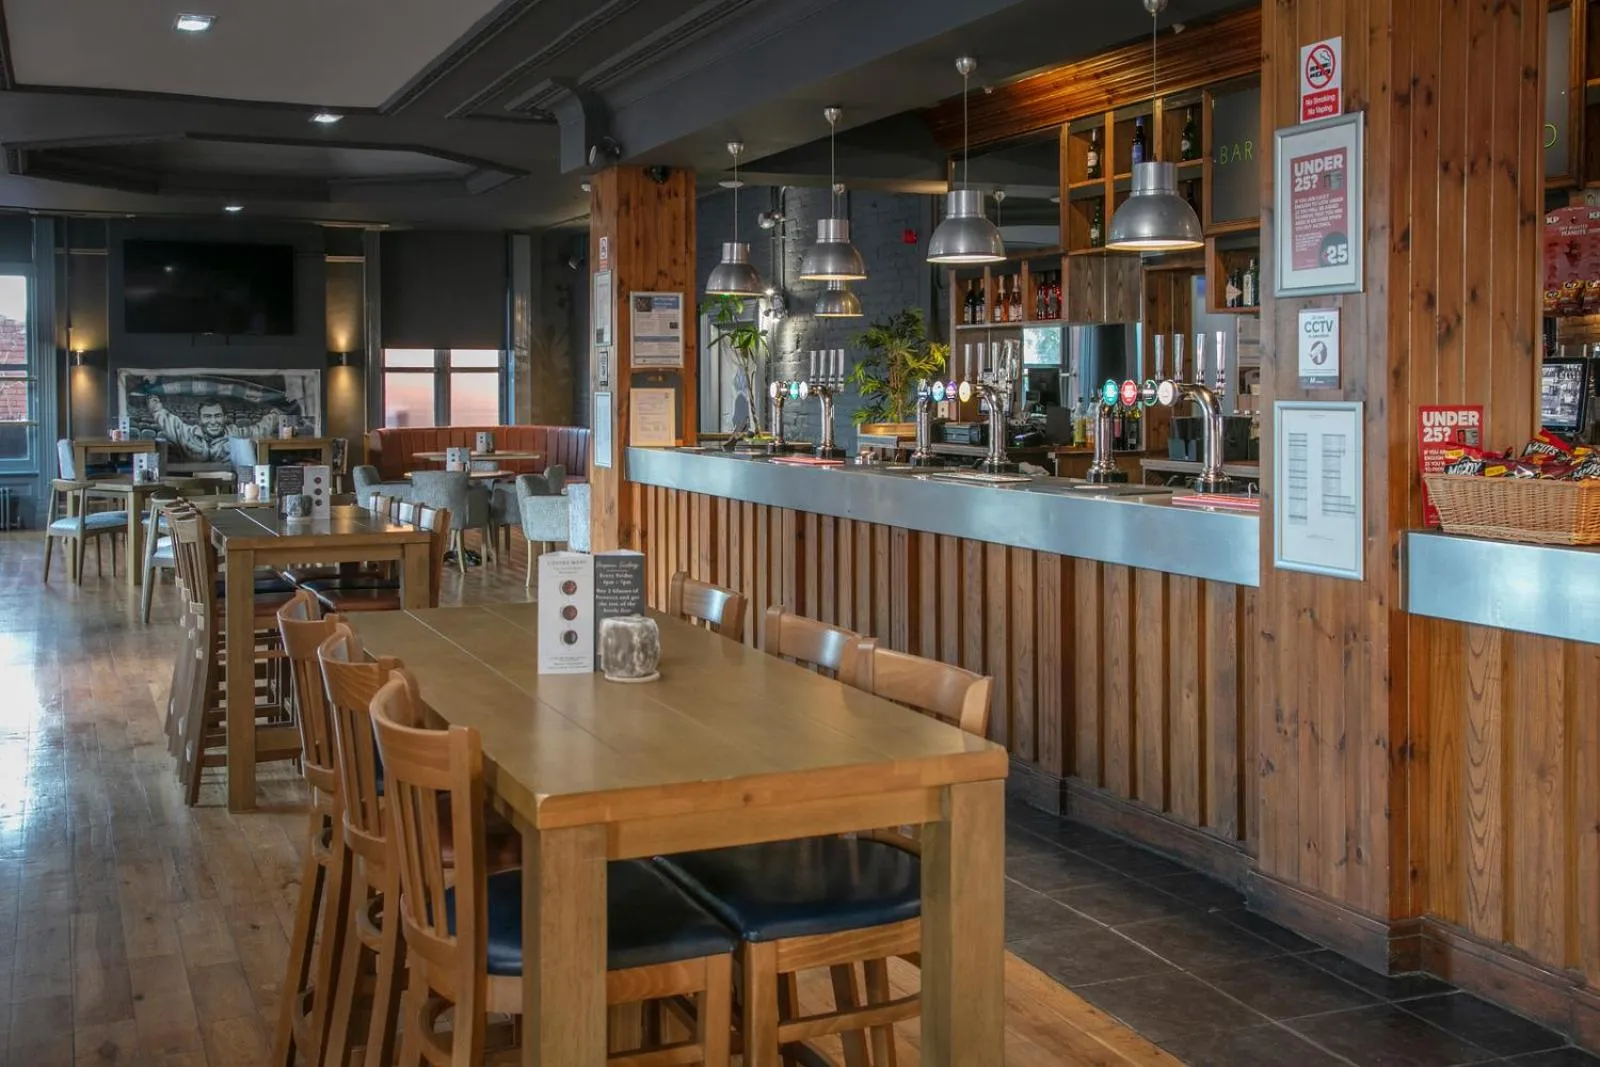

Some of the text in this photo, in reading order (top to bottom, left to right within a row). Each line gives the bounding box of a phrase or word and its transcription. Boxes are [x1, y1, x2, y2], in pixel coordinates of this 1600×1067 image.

[1220, 140, 1253, 165] BAR
[1294, 154, 1344, 177] UNDER
[1294, 174, 1318, 193] 25?
[1546, 216, 1560, 224] KP
[1327, 244, 1347, 264] 25
[1304, 320, 1334, 334] CCTV
[1422, 410, 1480, 426] UNDER
[1423, 427, 1451, 442] 25?
